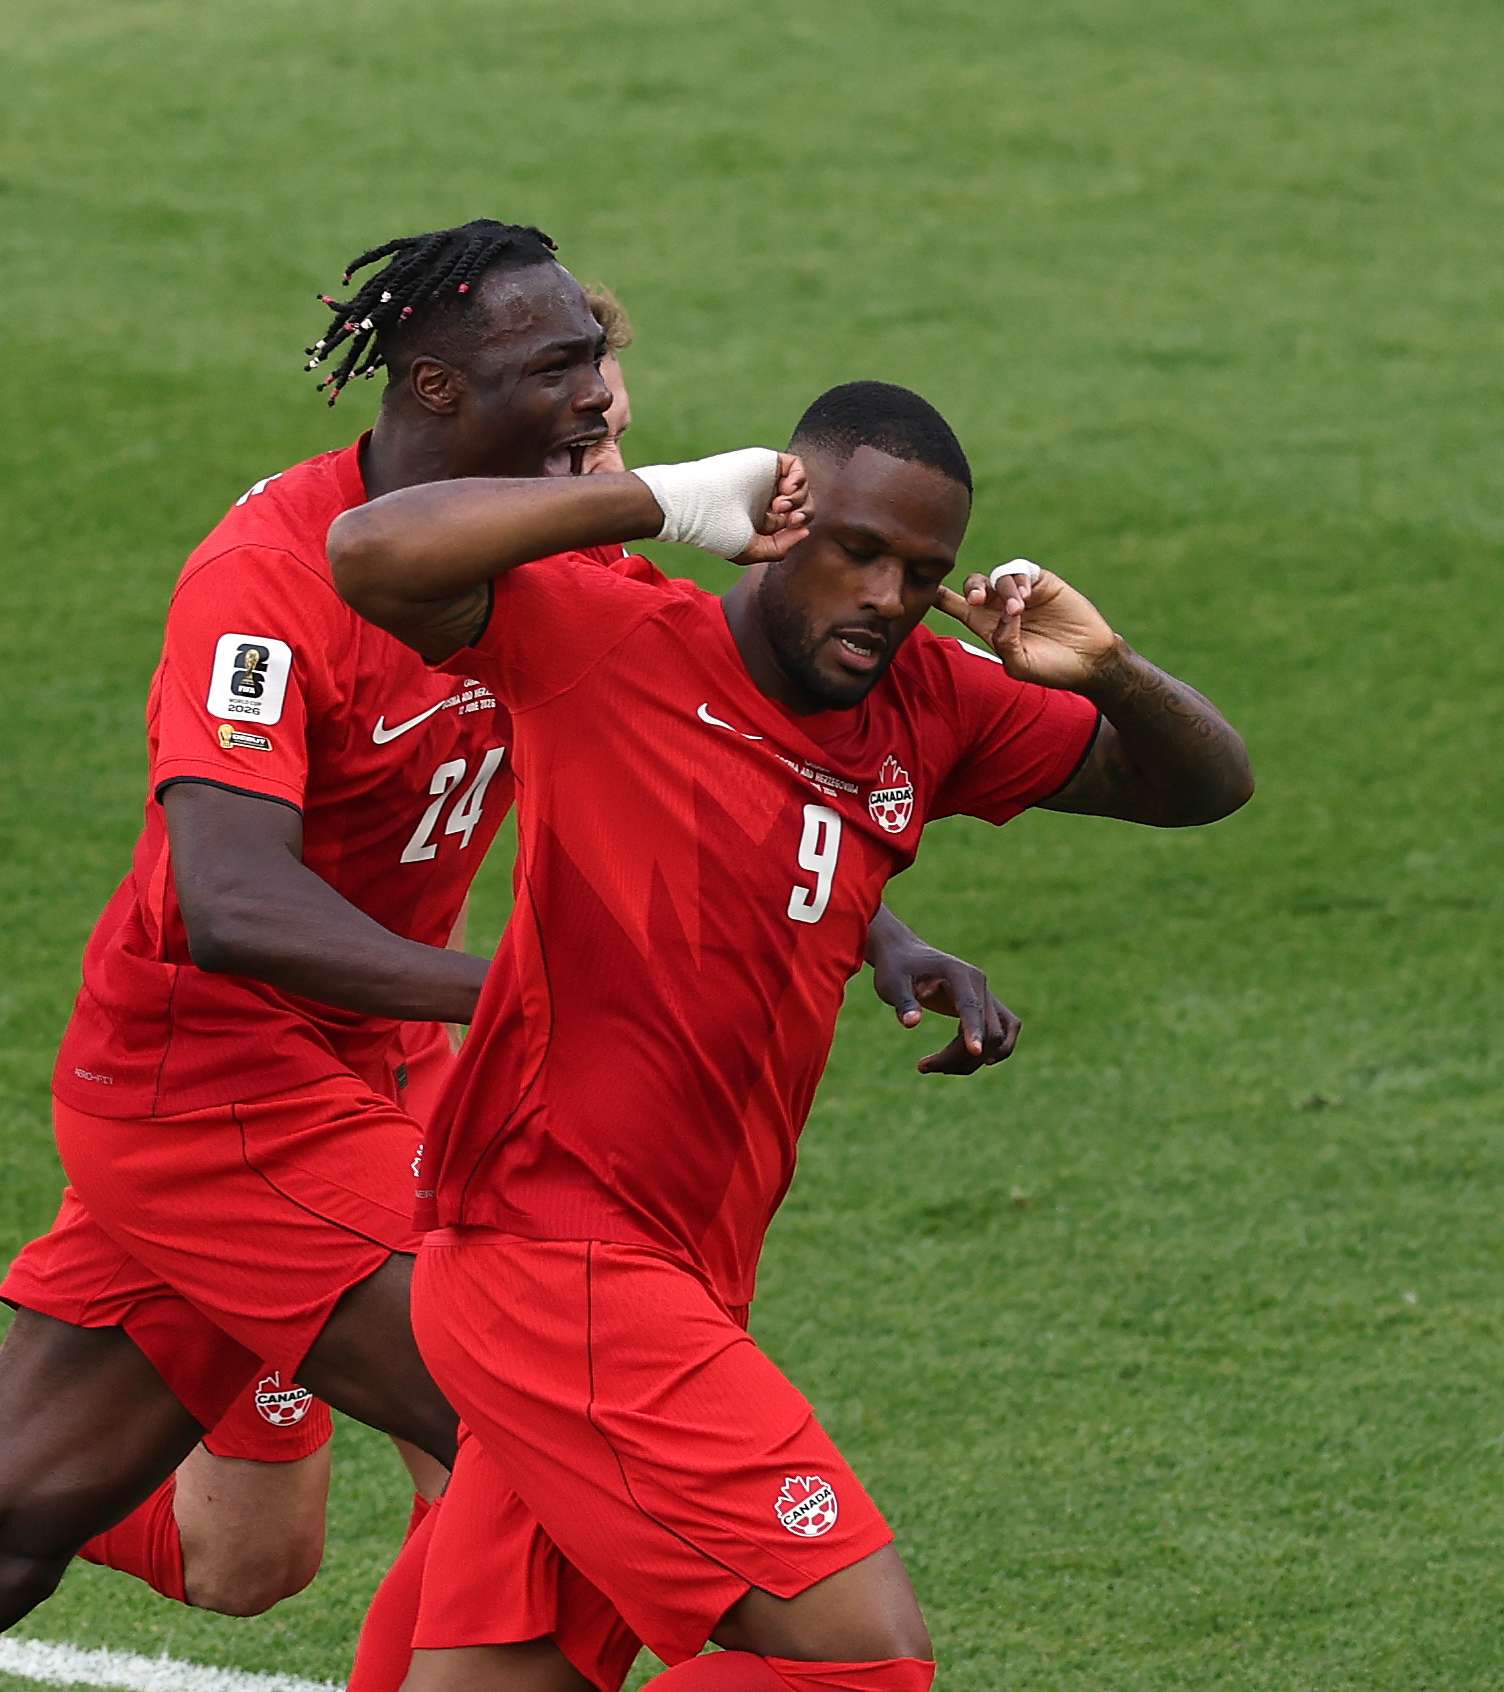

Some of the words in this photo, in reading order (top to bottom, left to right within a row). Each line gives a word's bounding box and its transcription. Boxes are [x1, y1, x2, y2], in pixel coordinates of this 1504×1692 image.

[228, 704, 261, 716] 2026
[400, 746, 505, 863] 24
[871, 788, 911, 804] CANADA
[787, 803, 842, 924] 9
[784, 1489, 831, 1525] CANADA
